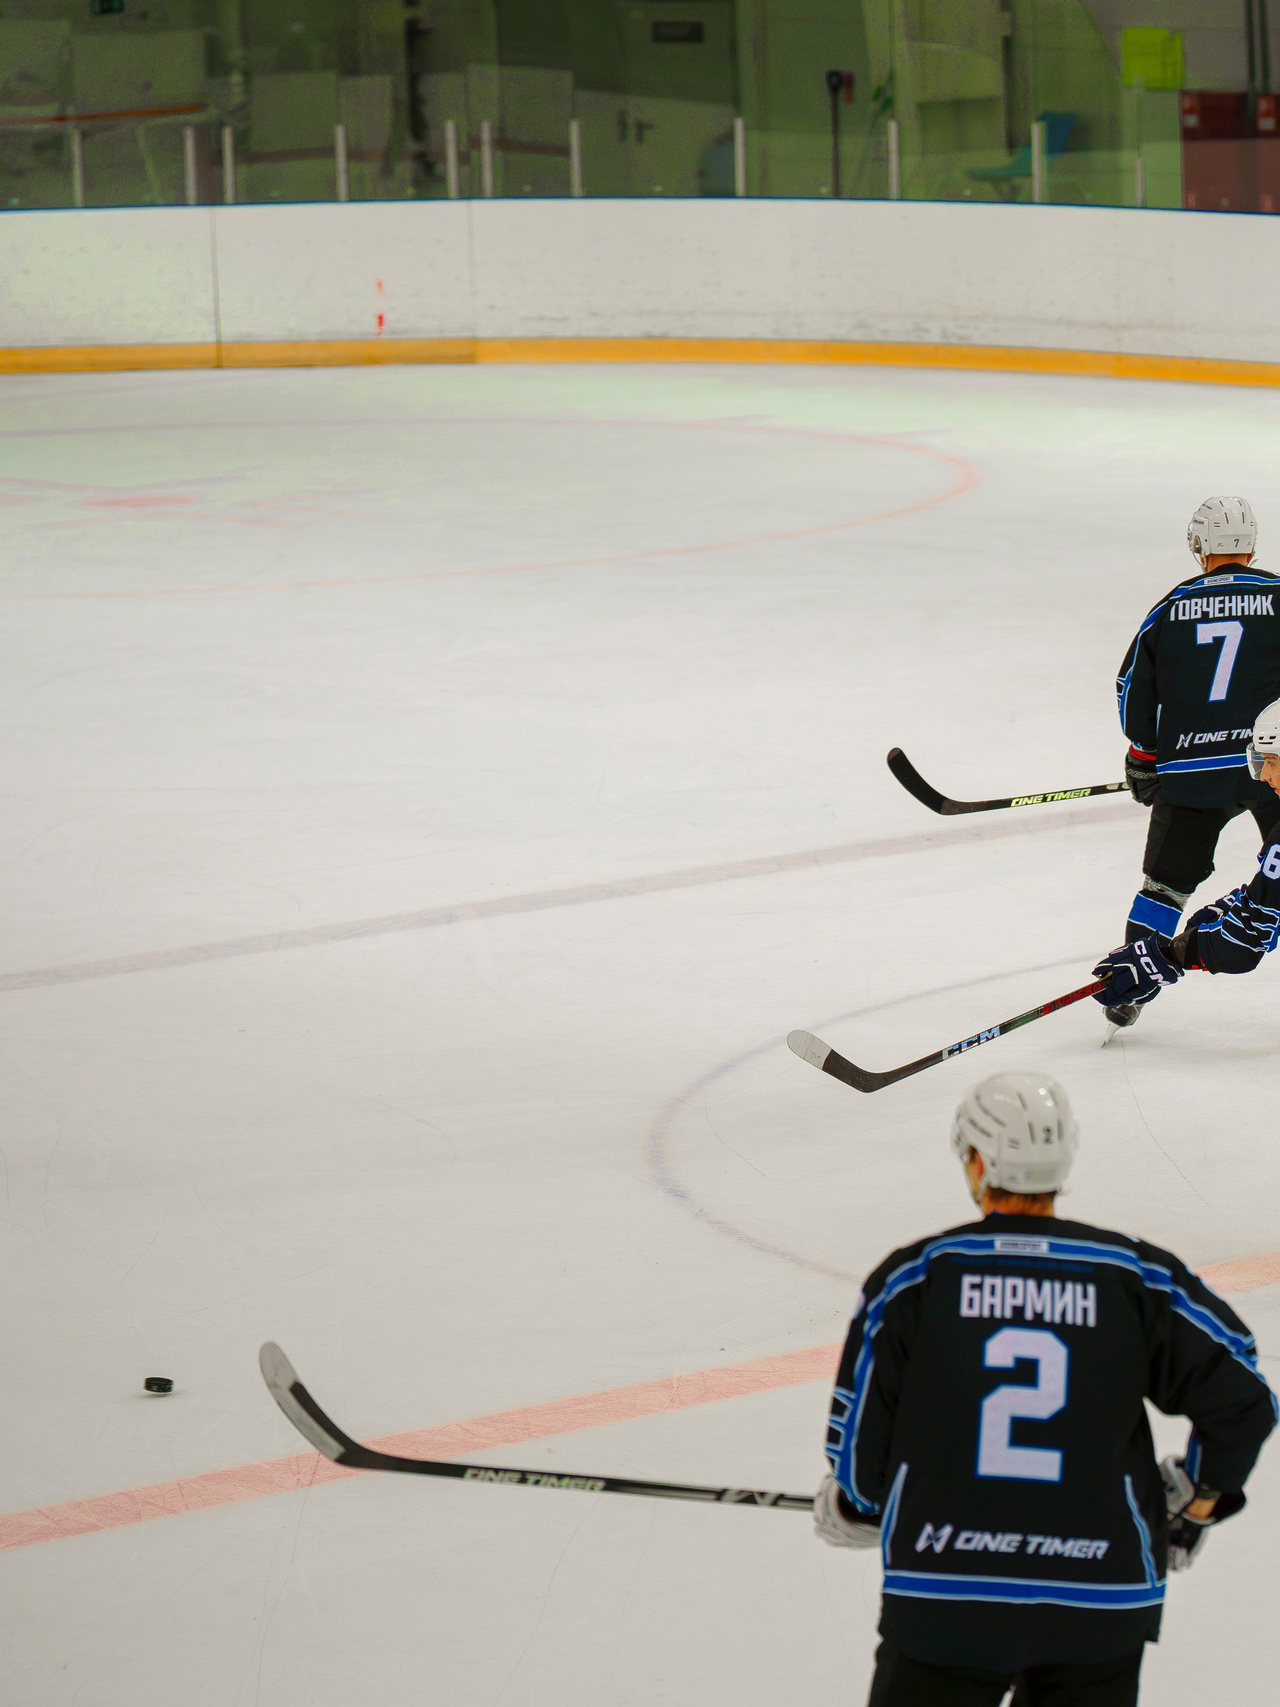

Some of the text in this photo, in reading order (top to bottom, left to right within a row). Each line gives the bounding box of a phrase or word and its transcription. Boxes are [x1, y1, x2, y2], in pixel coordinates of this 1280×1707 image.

[1234, 538, 1240, 548] 7
[1195, 619, 1244, 703] 7
[1193, 728, 1254, 744] ONE TIM
[1010, 788, 1092, 807] ONE TIMER
[1134, 940, 1171, 986] CCM
[942, 1026, 1000, 1061] CCM
[1043, 1126, 1053, 1144] 2
[960, 1274, 1096, 1328] БАРМИН
[975, 1326, 1069, 1482] 2
[953, 1530, 1110, 1559] ONE TIMER
